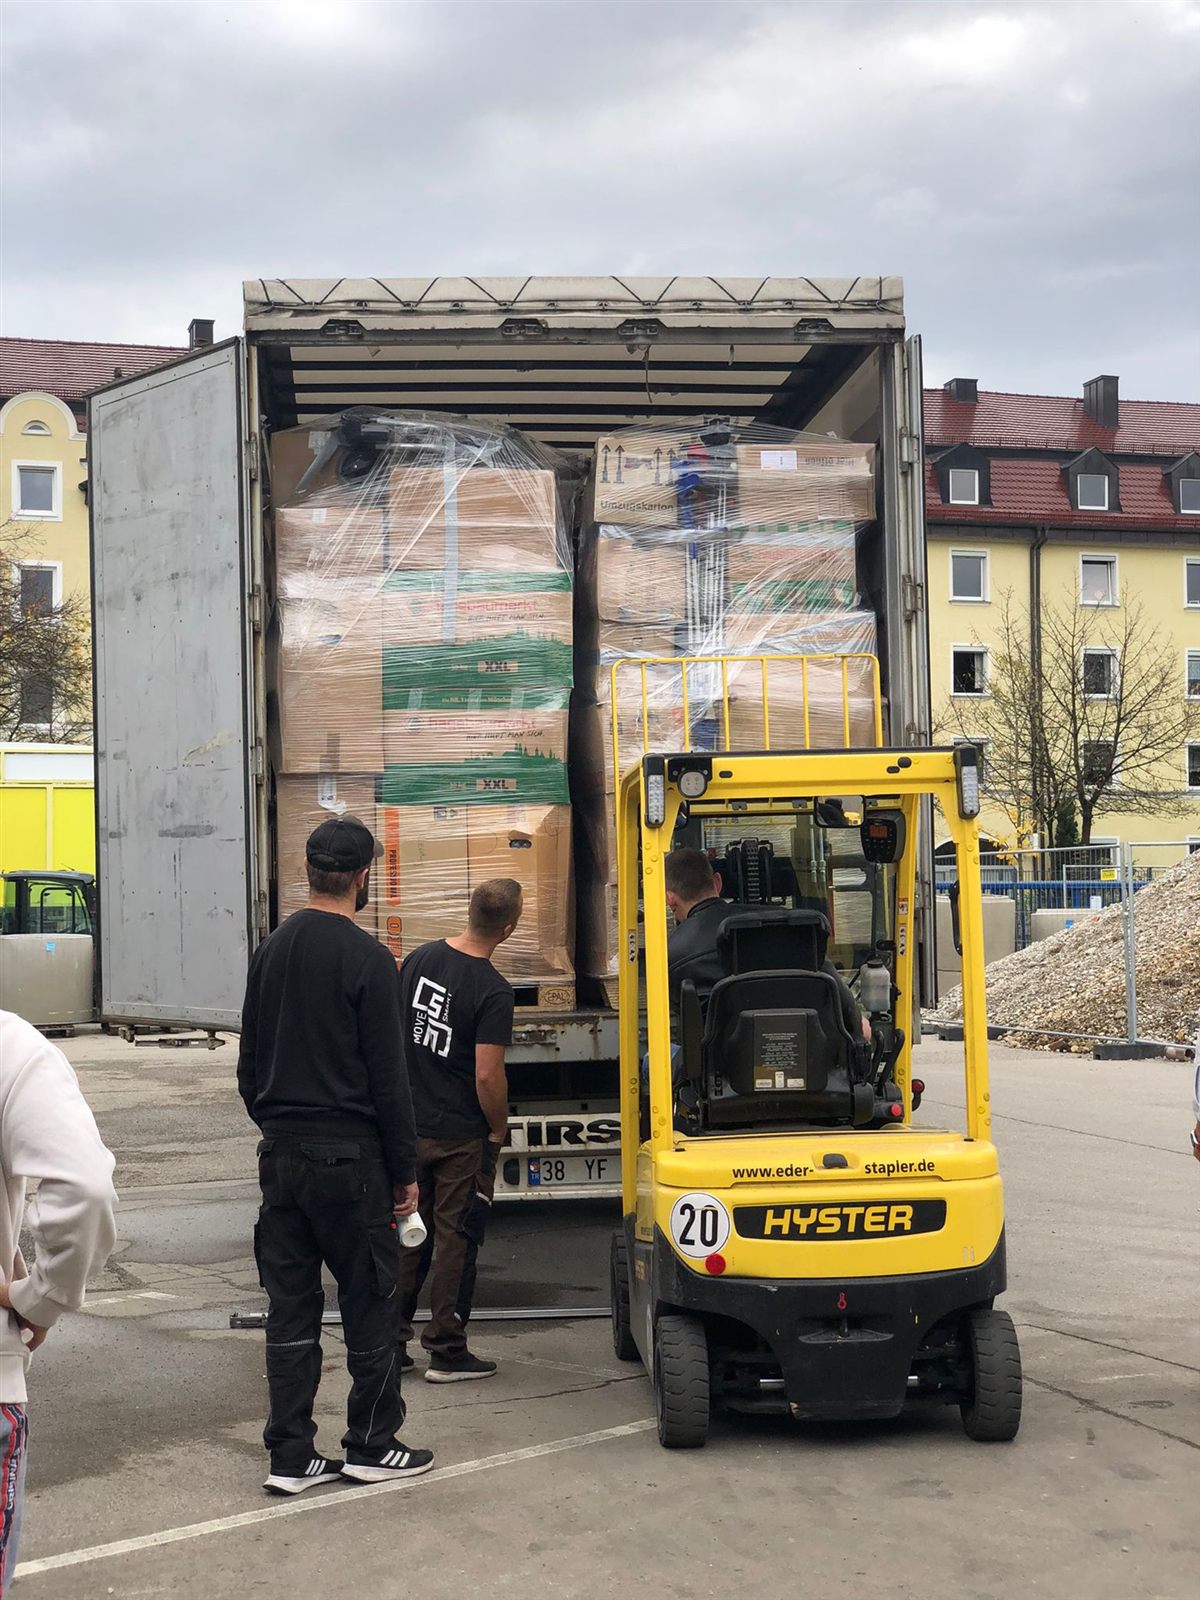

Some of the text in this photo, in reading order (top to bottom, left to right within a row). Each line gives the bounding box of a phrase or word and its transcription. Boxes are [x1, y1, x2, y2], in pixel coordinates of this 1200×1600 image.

[600, 500, 674, 513] Umzugskarton
[484, 661, 511, 673] XXL
[483, 779, 509, 790] XXL
[389, 849, 398, 898] PROFESSIONAL
[413, 1011, 427, 1044] MOVE
[542, 1160, 565, 1182] 38
[585, 1158, 608, 1180] YF
[732, 1159, 935, 1179] www.eder- stapler.de
[679, 1203, 718, 1248] 20
[763, 1204, 914, 1236] HYSTER
